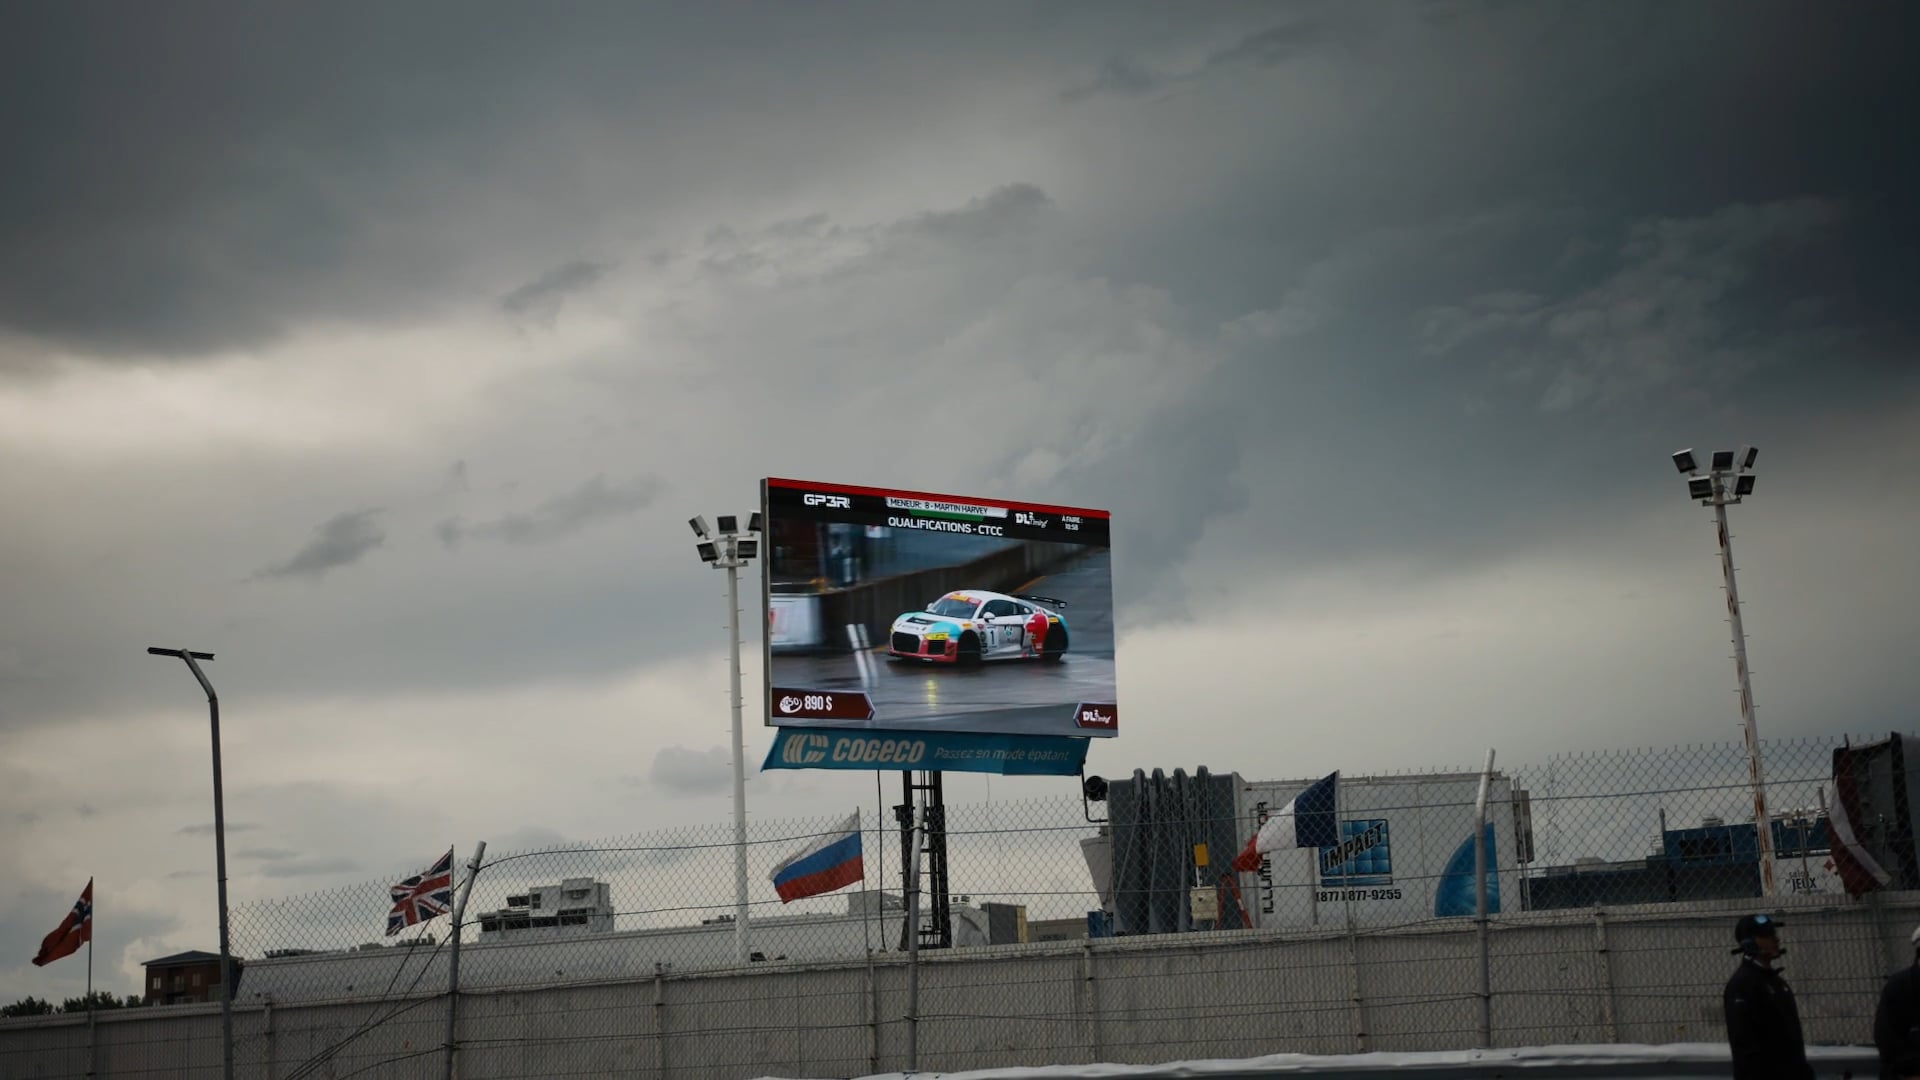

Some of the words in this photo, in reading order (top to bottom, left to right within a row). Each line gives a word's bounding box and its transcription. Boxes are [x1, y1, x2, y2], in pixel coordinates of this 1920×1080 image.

[890, 498, 921, 509] MENEUR:
[934, 503, 961, 512] MARTIN
[961, 505, 988, 515] HARVEY
[888, 516, 972, 534] QUALIFICATIONS
[978, 524, 1003, 536] CTCC
[990, 630, 995, 645] 1
[804, 695, 824, 710] 890
[825, 695, 833, 711] $
[934, 747, 974, 760] Passez
[975, 749, 990, 760] en
[991, 748, 1025, 761] mode
[1027, 748, 1070, 763] épatant
[1323, 823, 1384, 872] IMPACT
[1792, 877, 1817, 893] JEUX
[1348, 889, 1402, 901] 877-9255
